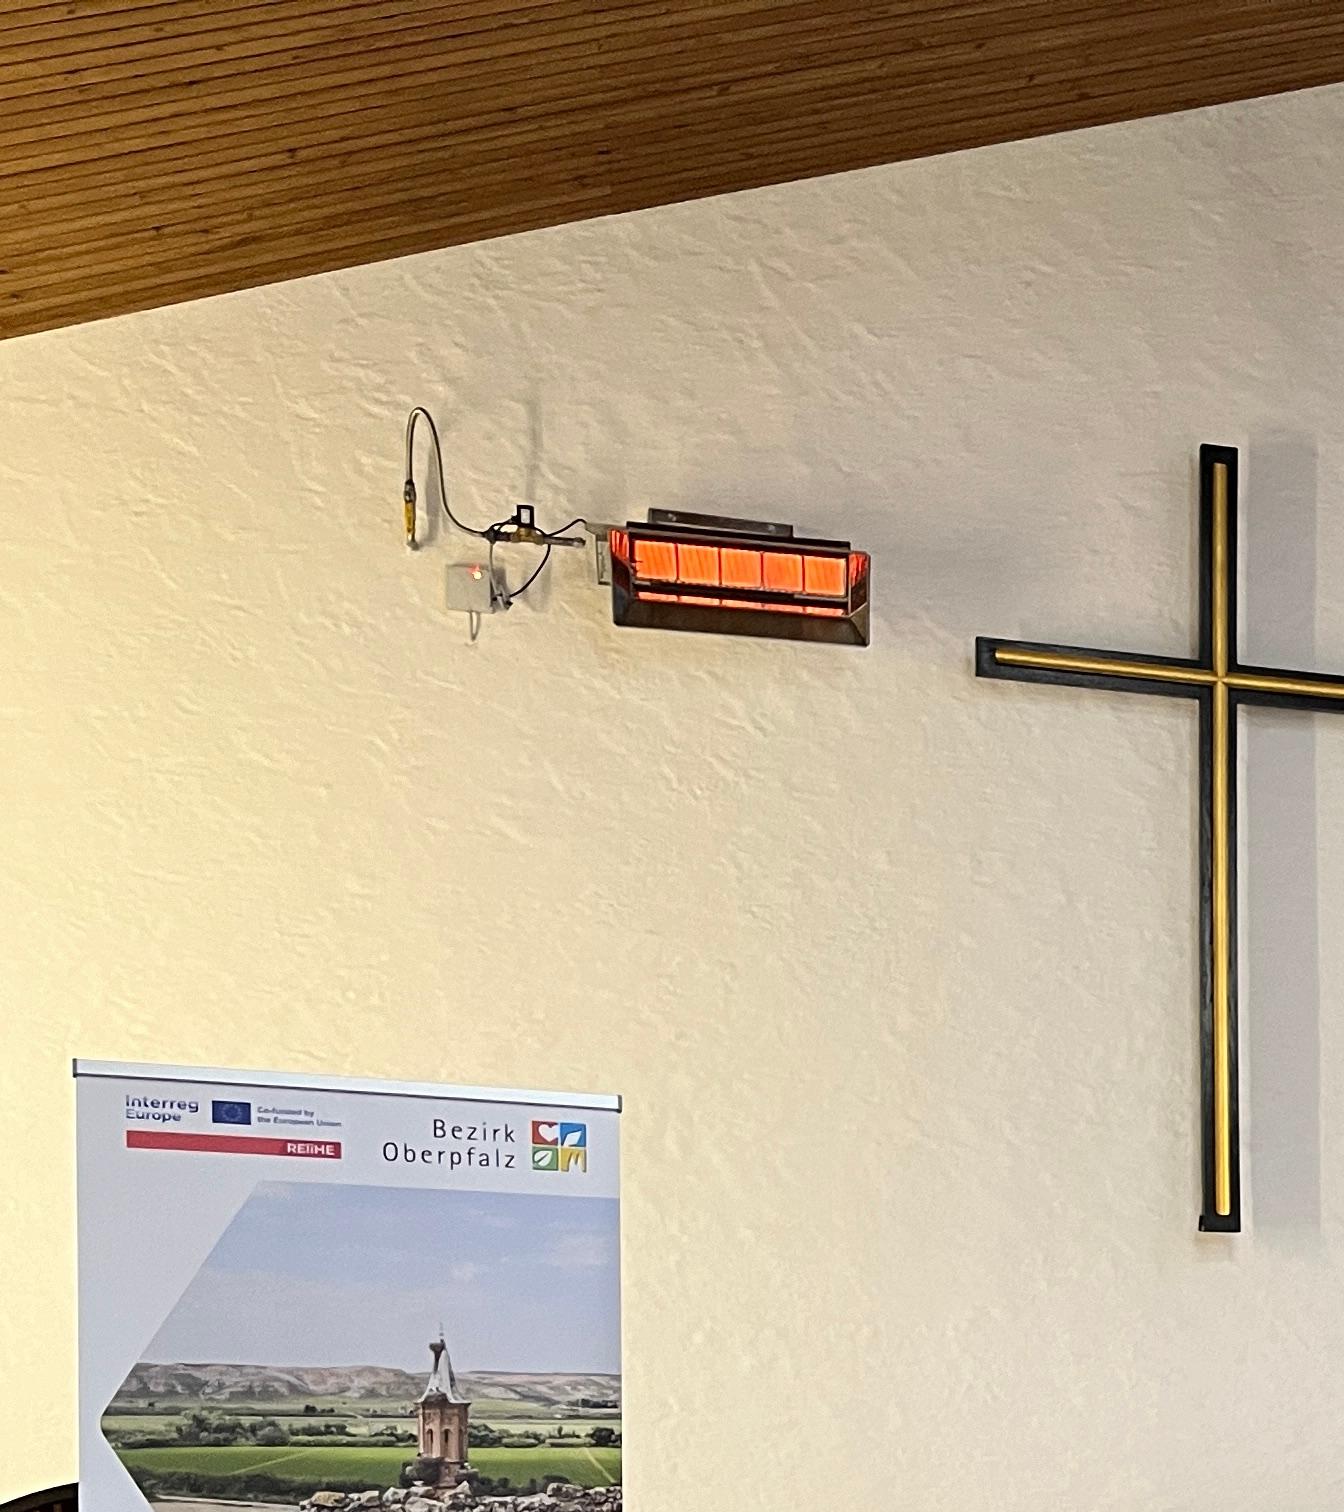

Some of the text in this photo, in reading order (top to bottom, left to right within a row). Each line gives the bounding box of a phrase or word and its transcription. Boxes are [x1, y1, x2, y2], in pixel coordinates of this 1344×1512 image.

[125, 1094, 200, 1113] Interreg
[125, 1108, 182, 1123] Europe
[432, 1118, 516, 1143] Bezirk
[382, 1141, 516, 1170] Oberpfalz
